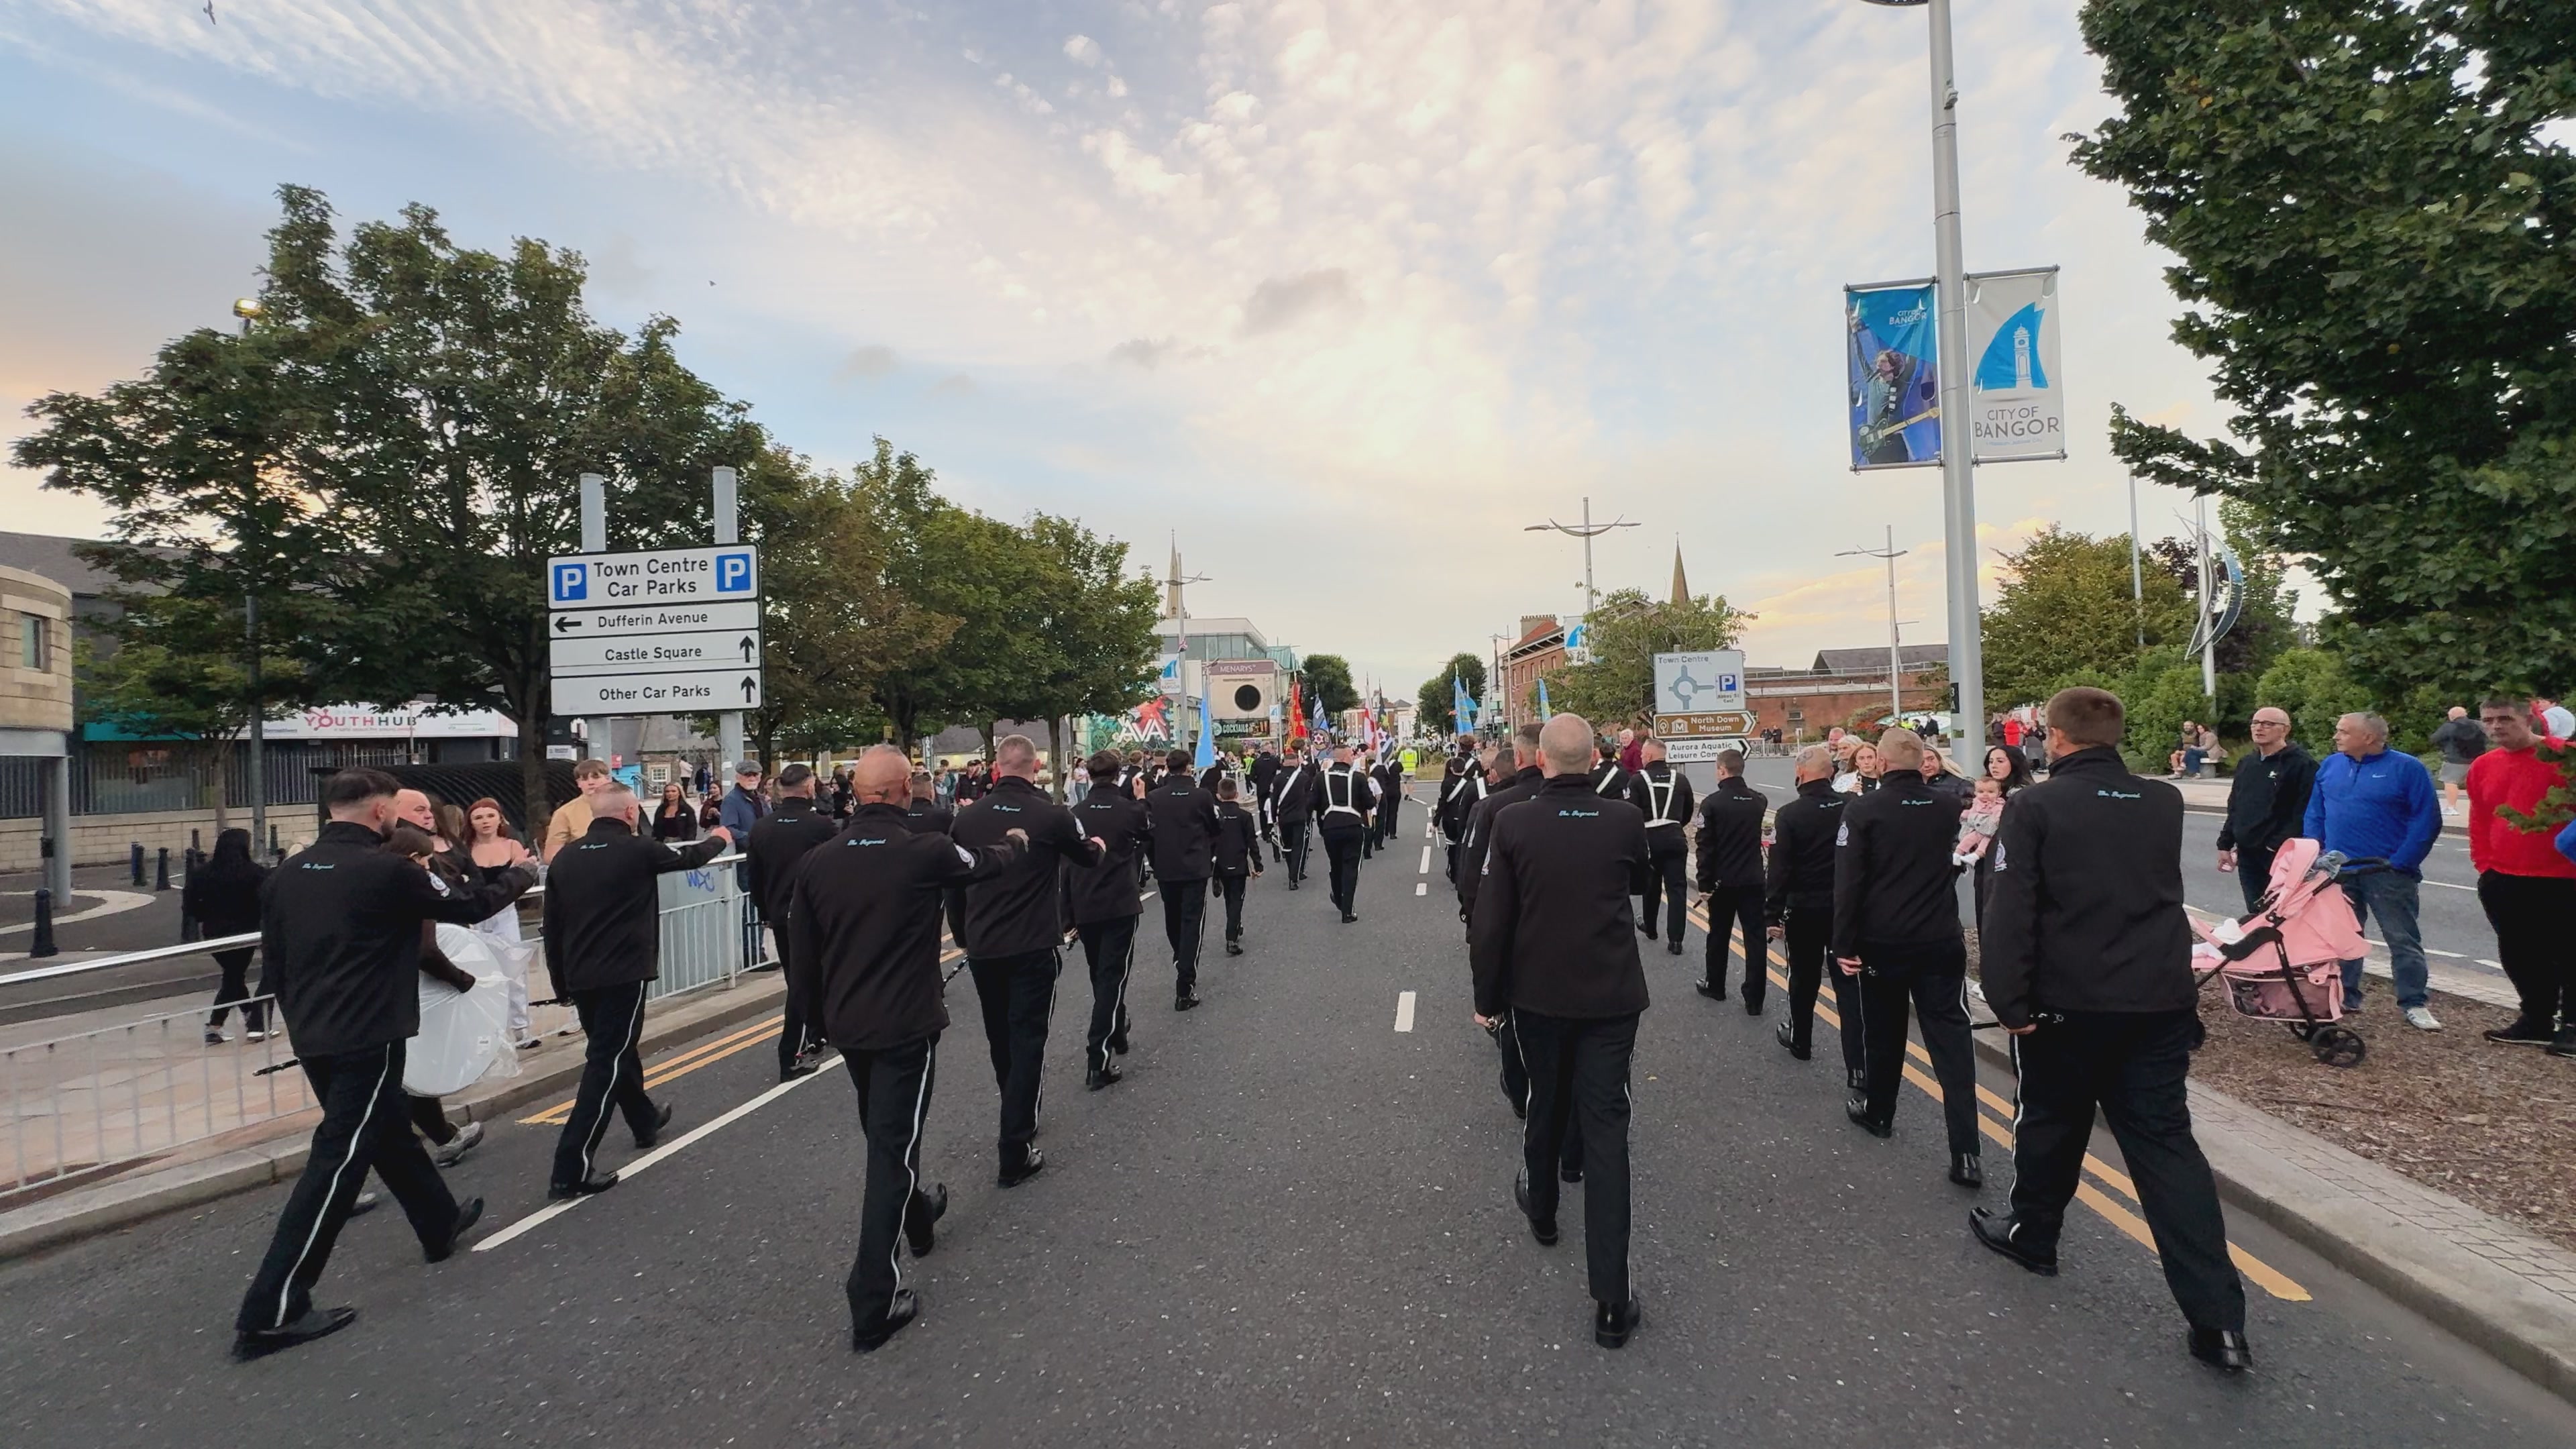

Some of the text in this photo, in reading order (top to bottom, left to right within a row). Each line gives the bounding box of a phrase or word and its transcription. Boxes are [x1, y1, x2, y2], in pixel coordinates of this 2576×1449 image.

[1889, 312, 1927, 325] BANGOR
[1987, 406, 2039, 421] CITY OF
[1974, 417, 2059, 438] BANGOR
[594, 557, 708, 577] Town Centre
[608, 579, 697, 597] Car Parks
[598, 613, 708, 628] Dufferin Avenue
[605, 647, 702, 661] Castle Square
[1220, 665, 1253, 673] MENARYS
[599, 685, 710, 700] Other Car Parks
[1223, 724, 1248, 733] COCKTAILS
